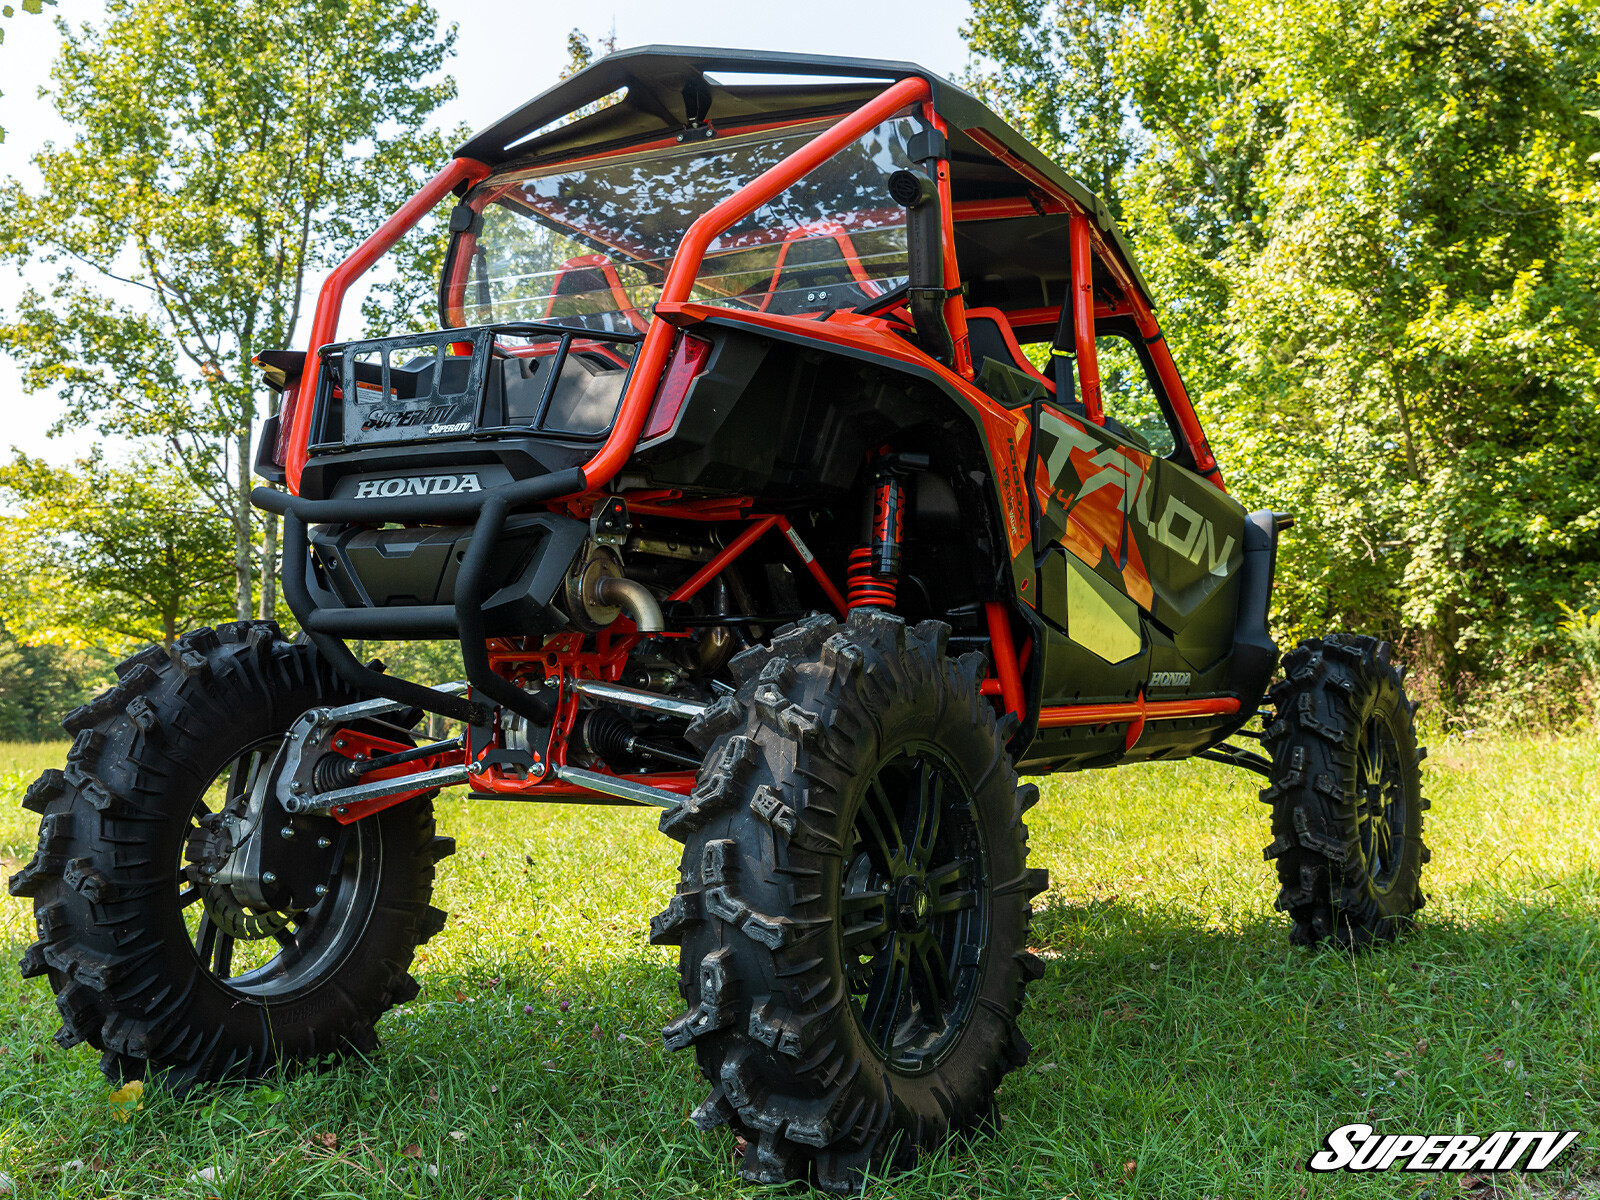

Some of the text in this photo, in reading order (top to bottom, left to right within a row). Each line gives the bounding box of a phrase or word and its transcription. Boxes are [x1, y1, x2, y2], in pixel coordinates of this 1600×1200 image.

[361, 404, 458, 432] SUPERATV
[428, 422, 471, 434] SUPERATV
[354, 474, 482, 499] HONDA
[1039, 410, 1236, 577] TALON
[1056, 488, 1075, 510] 4
[872, 485, 890, 542] FOX
[1148, 671, 1192, 687] HONDA
